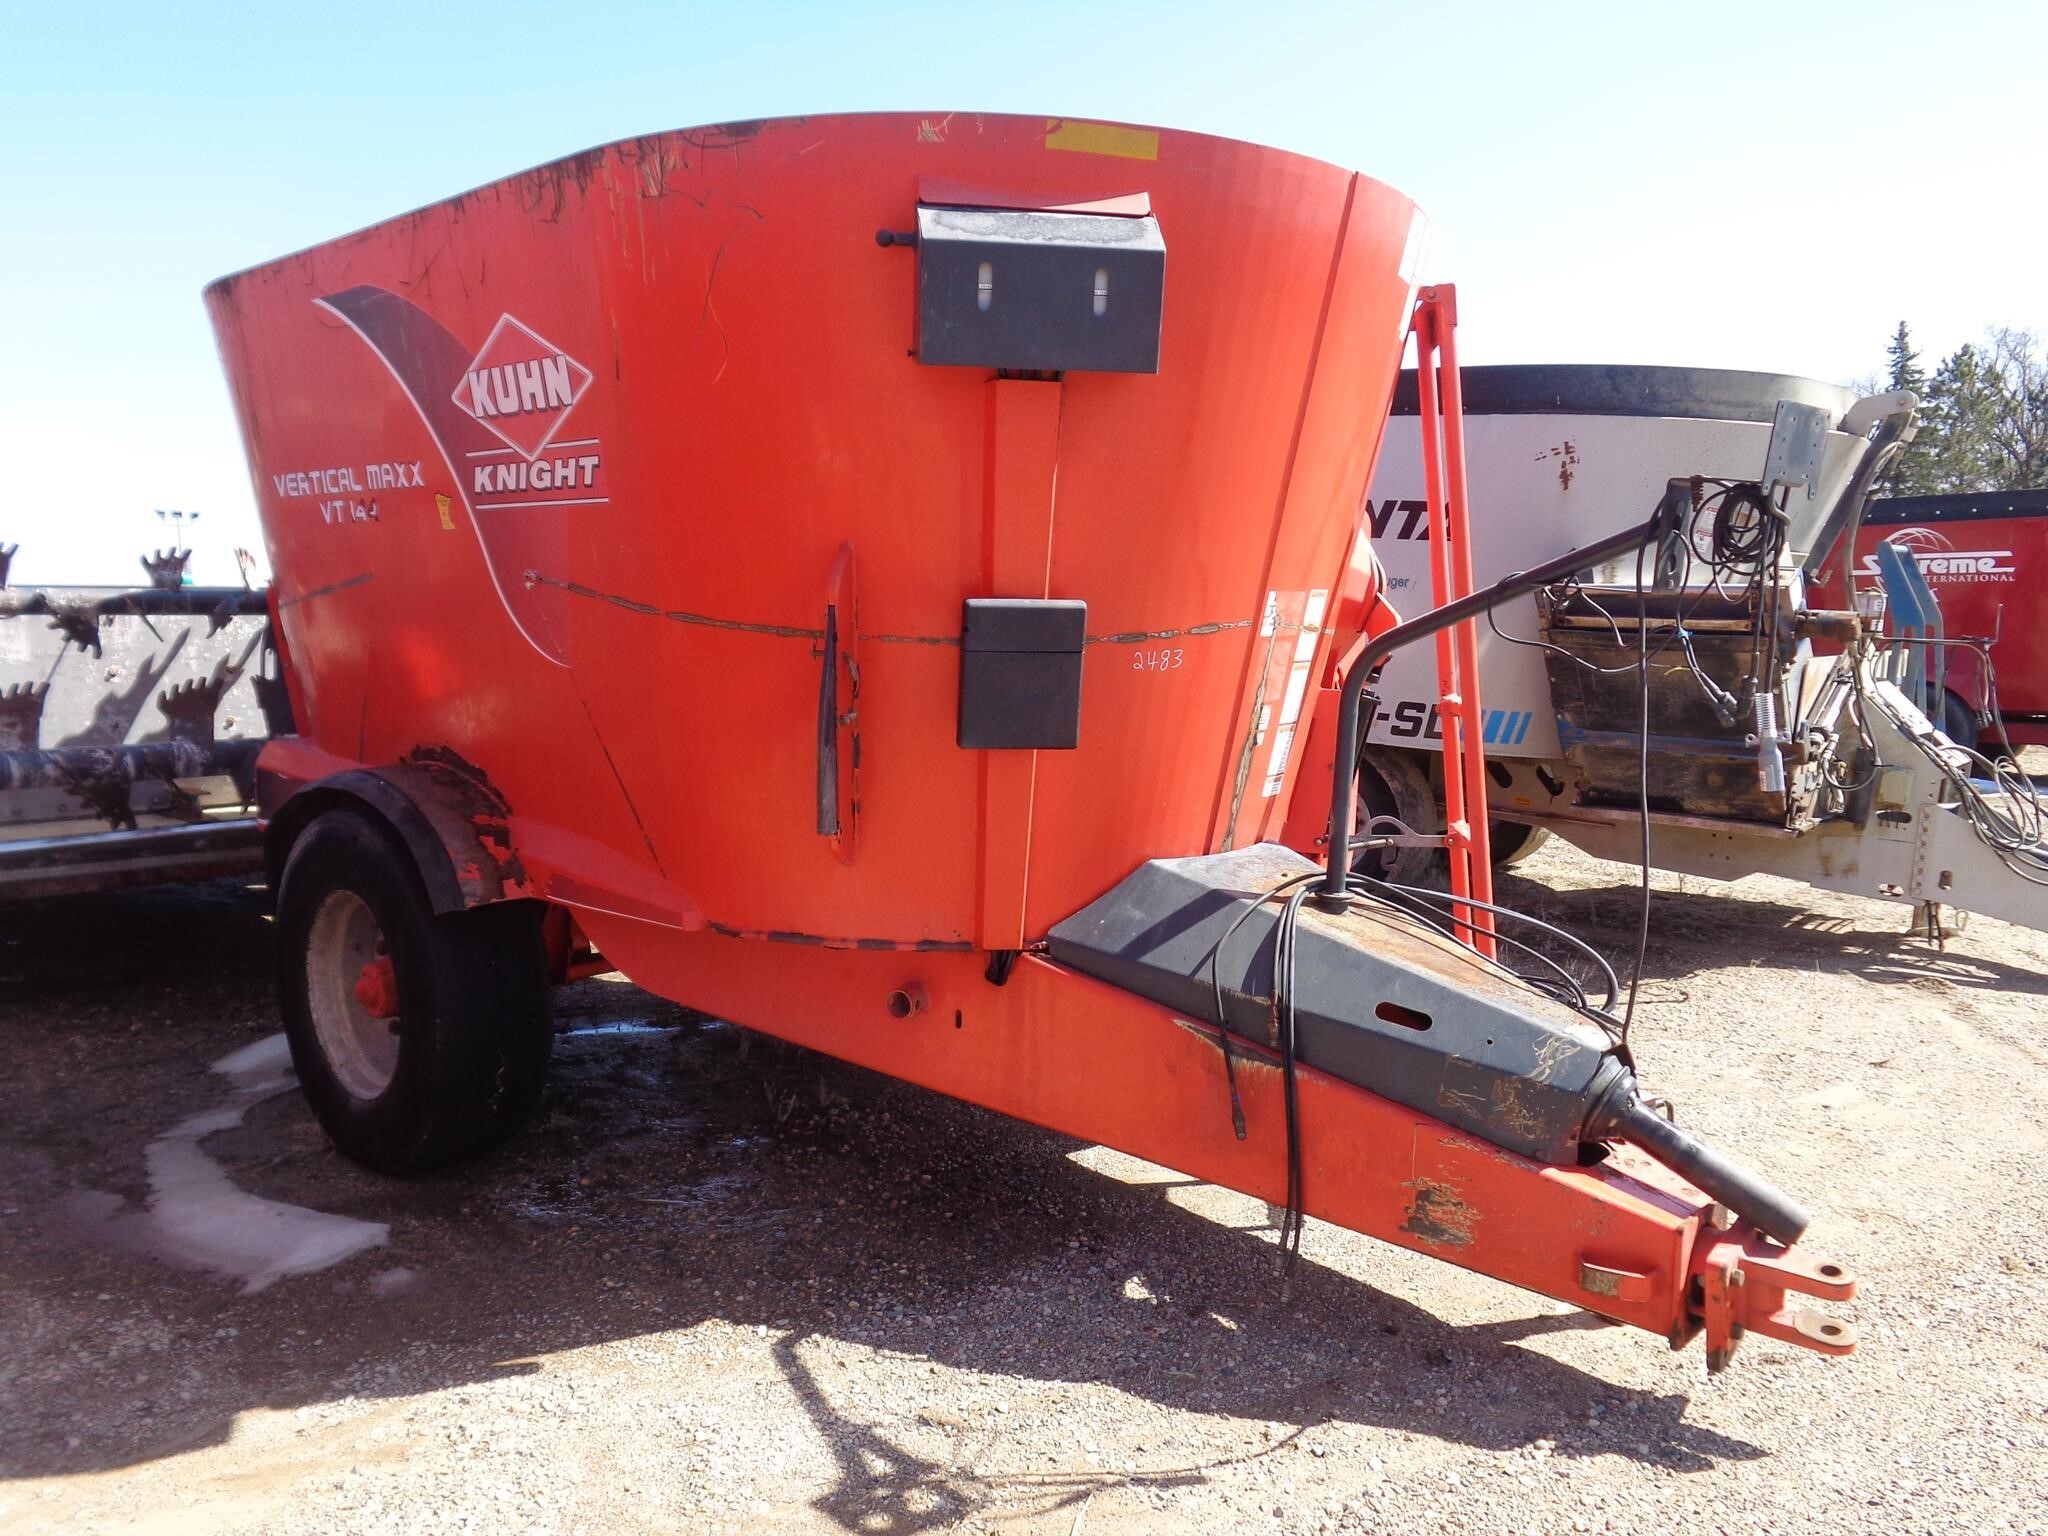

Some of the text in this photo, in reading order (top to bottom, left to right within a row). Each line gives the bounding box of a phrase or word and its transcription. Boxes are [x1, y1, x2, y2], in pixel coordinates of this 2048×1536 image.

[467, 354, 573, 418] KUHN
[273, 461, 424, 497] VERTICAL MAXX
[474, 455, 600, 495] KNIGHT
[319, 500, 345, 524] VT
[1853, 551, 2016, 575] Sreme
[1133, 649, 1184, 671] 2483
